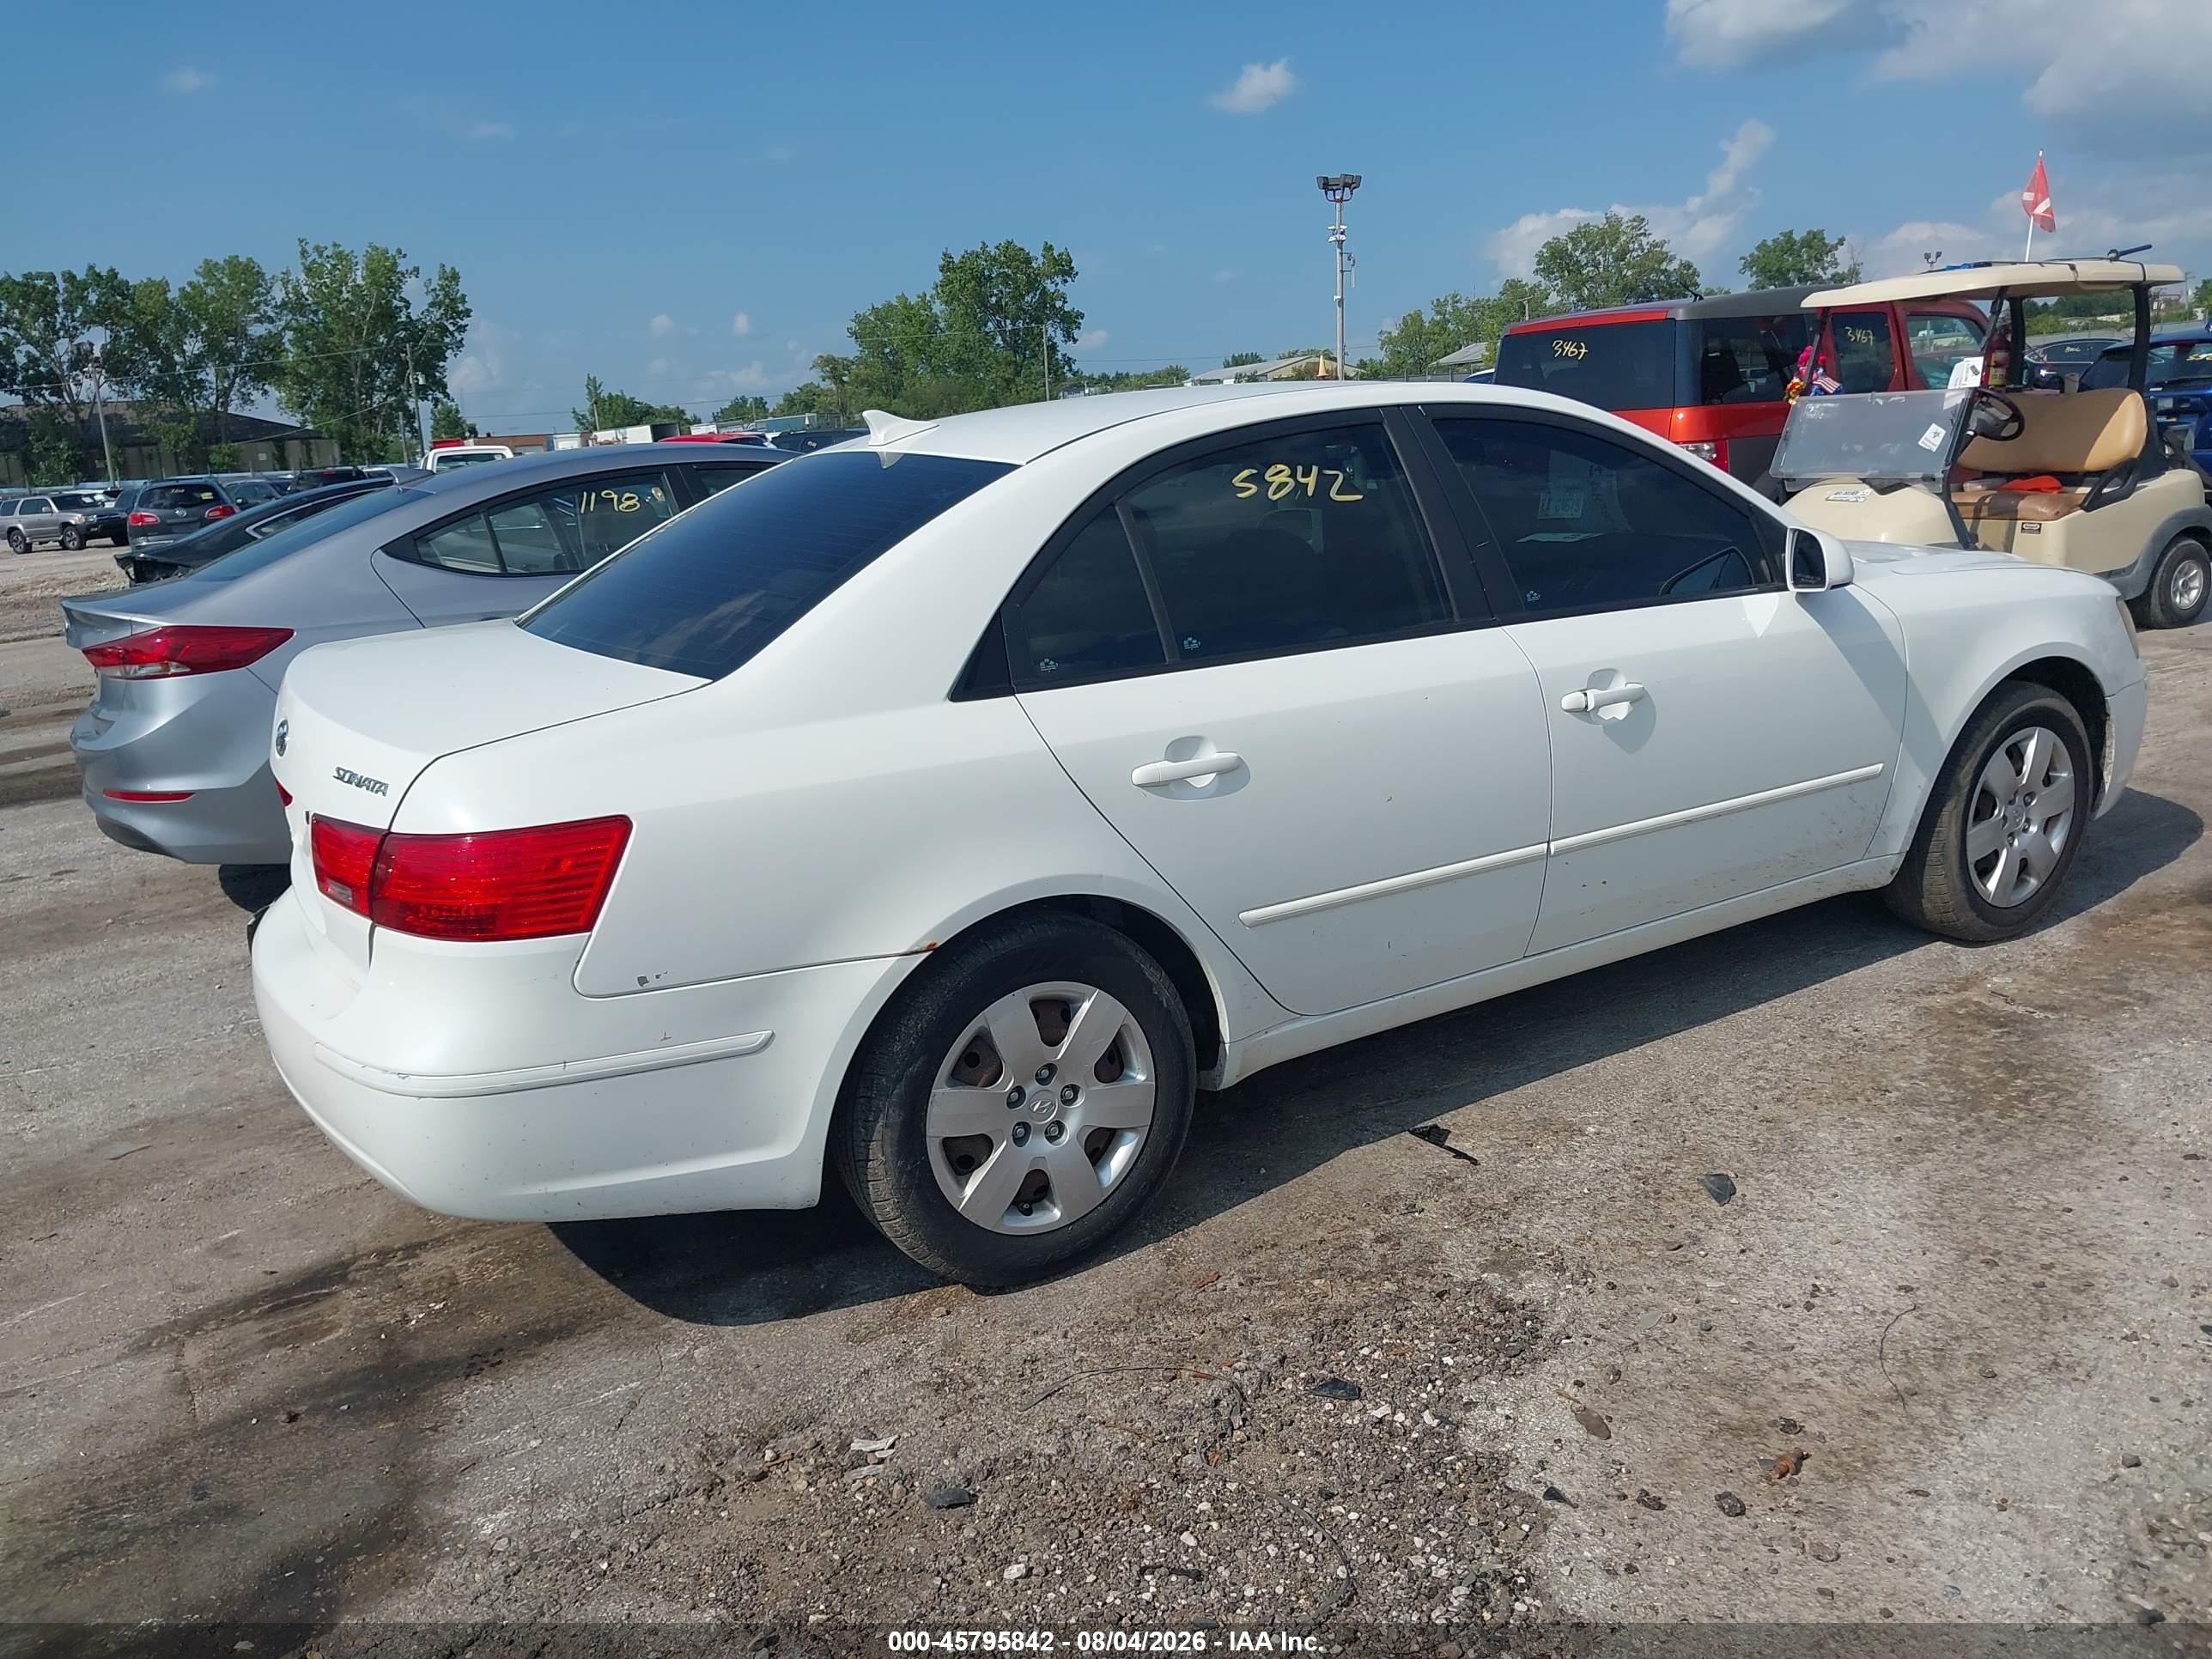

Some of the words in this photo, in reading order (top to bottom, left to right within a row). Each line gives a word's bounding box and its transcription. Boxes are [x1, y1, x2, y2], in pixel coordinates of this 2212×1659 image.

[1844, 326, 1875, 347] 3467
[1552, 339, 1589, 360] 3467
[1231, 464, 1364, 501] 5842
[580, 489, 641, 514] 1198
[332, 766, 389, 797] SONATA
